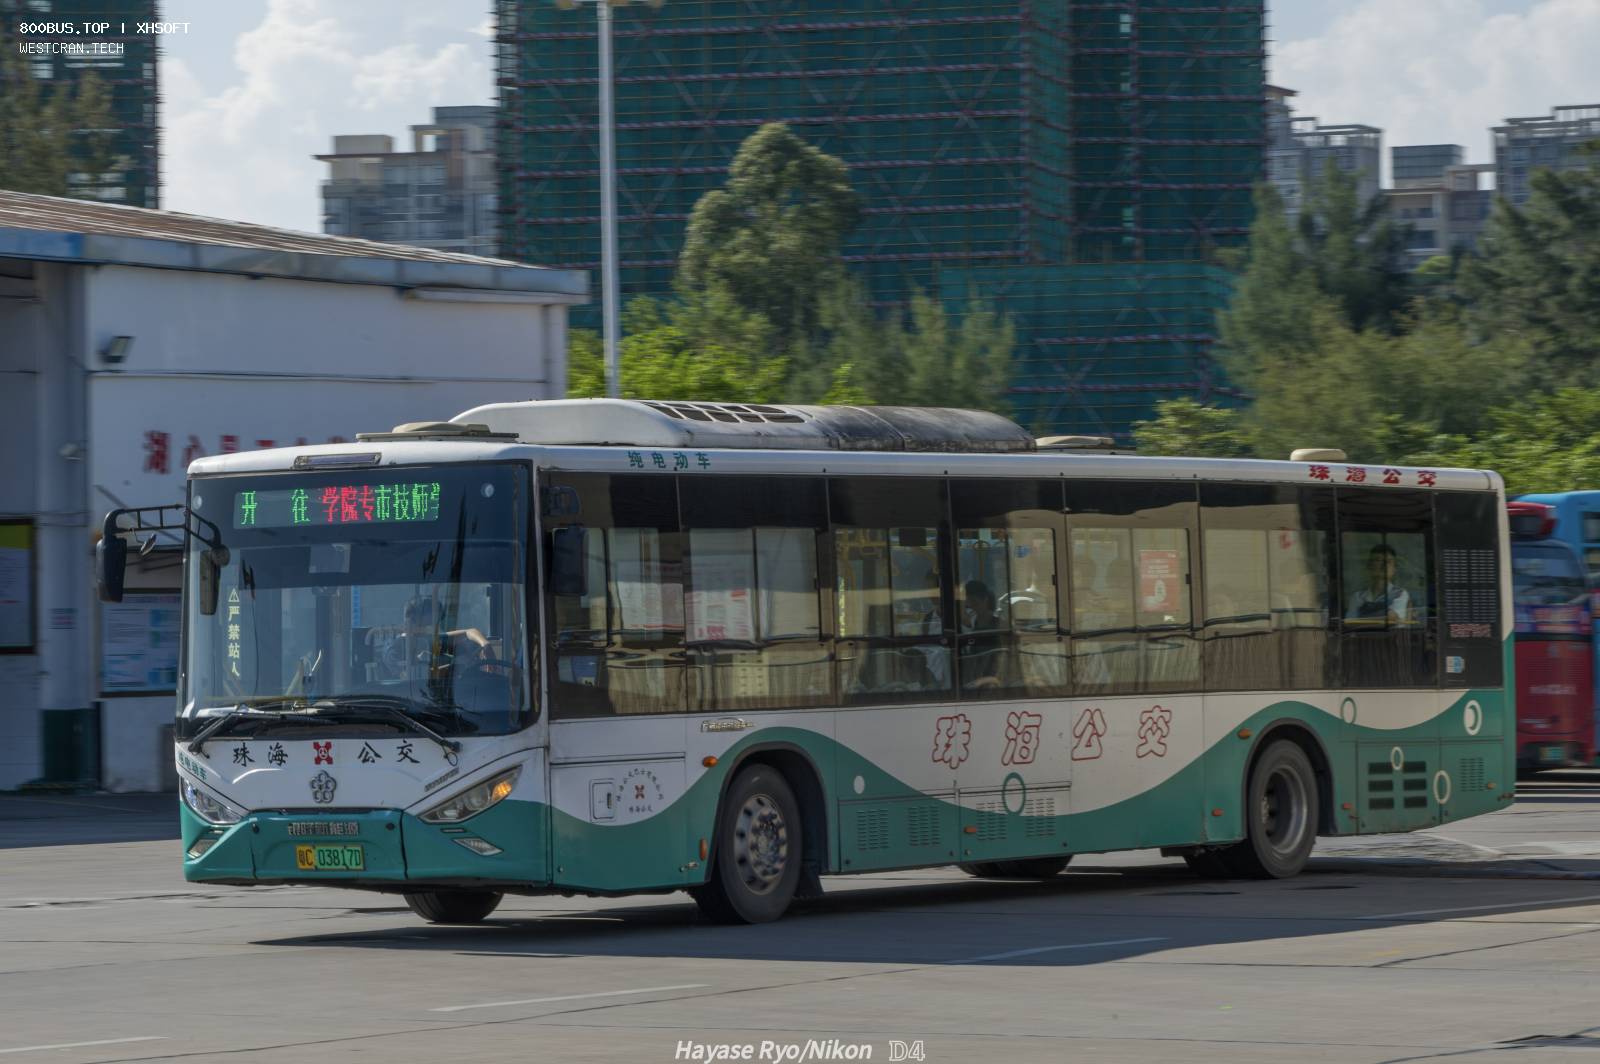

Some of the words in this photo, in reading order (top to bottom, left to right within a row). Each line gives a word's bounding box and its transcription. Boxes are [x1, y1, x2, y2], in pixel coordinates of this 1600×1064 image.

[627, 450, 711, 470] 纯电动车
[1308, 464, 1437, 487] 珠海公交
[228, 605, 240, 677] 严禁站人
[931, 705, 1172, 770] 珠海公交
